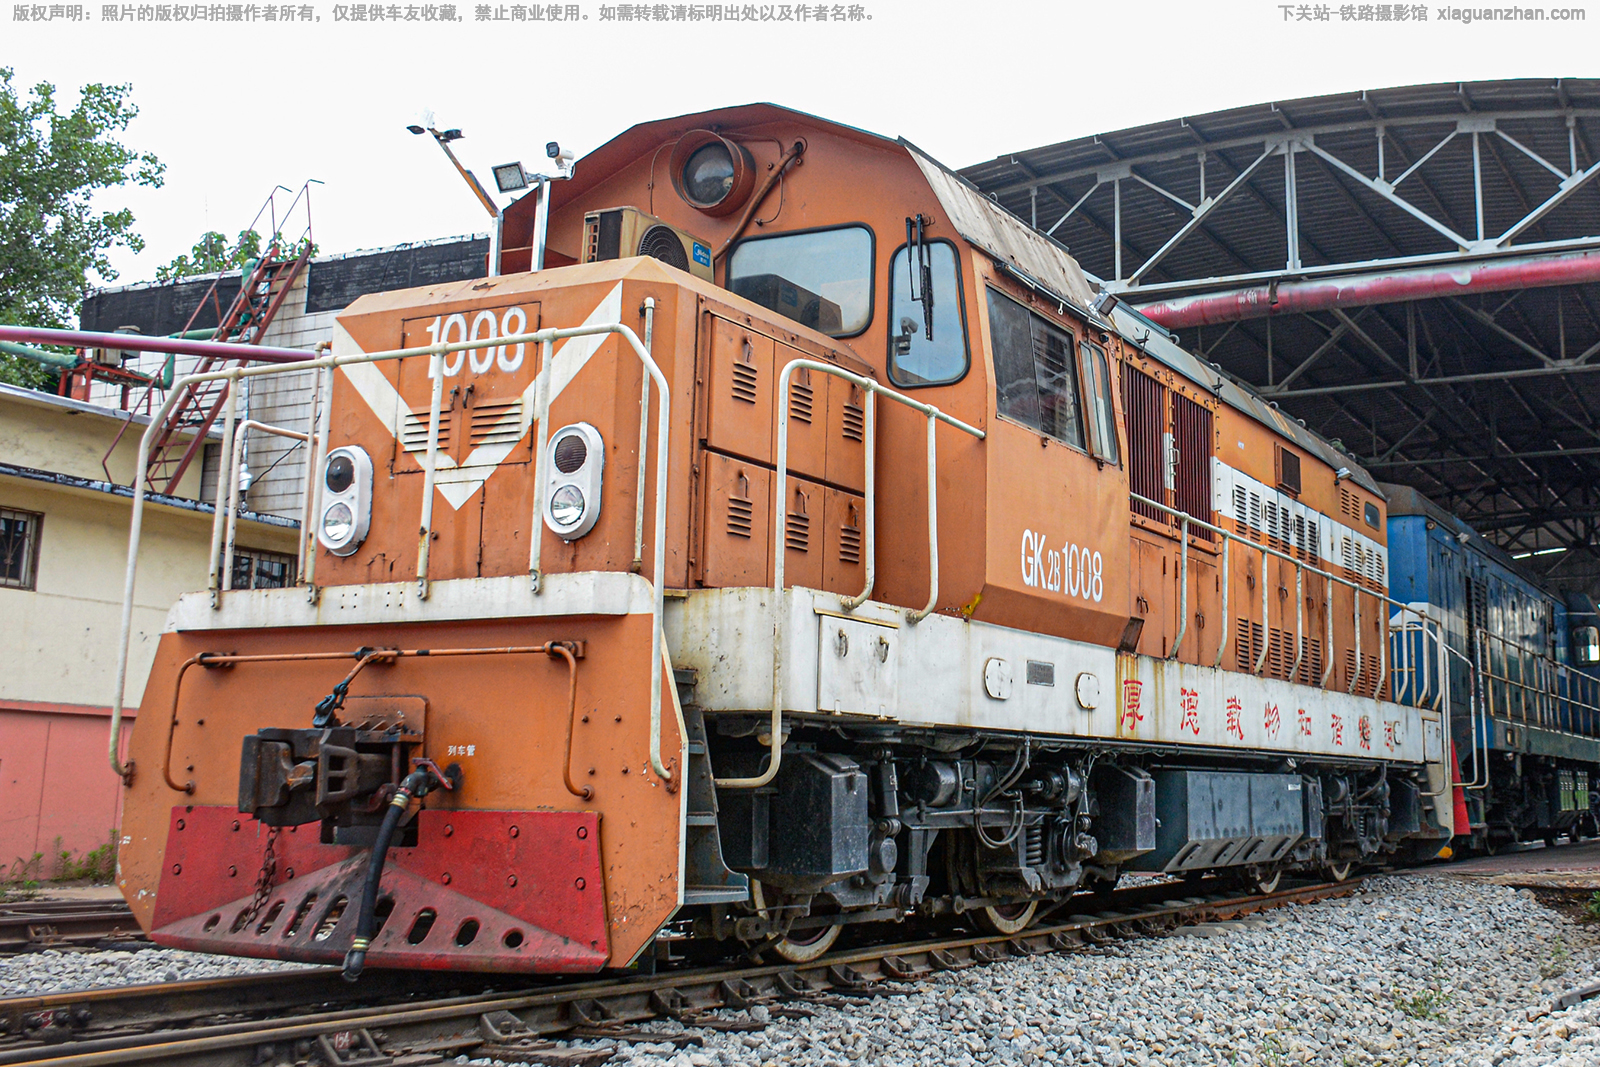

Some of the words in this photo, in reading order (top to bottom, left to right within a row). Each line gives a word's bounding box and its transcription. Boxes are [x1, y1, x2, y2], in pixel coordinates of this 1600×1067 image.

[426, 306, 527, 379] 1008
[447, 744, 476, 756] 列车管
